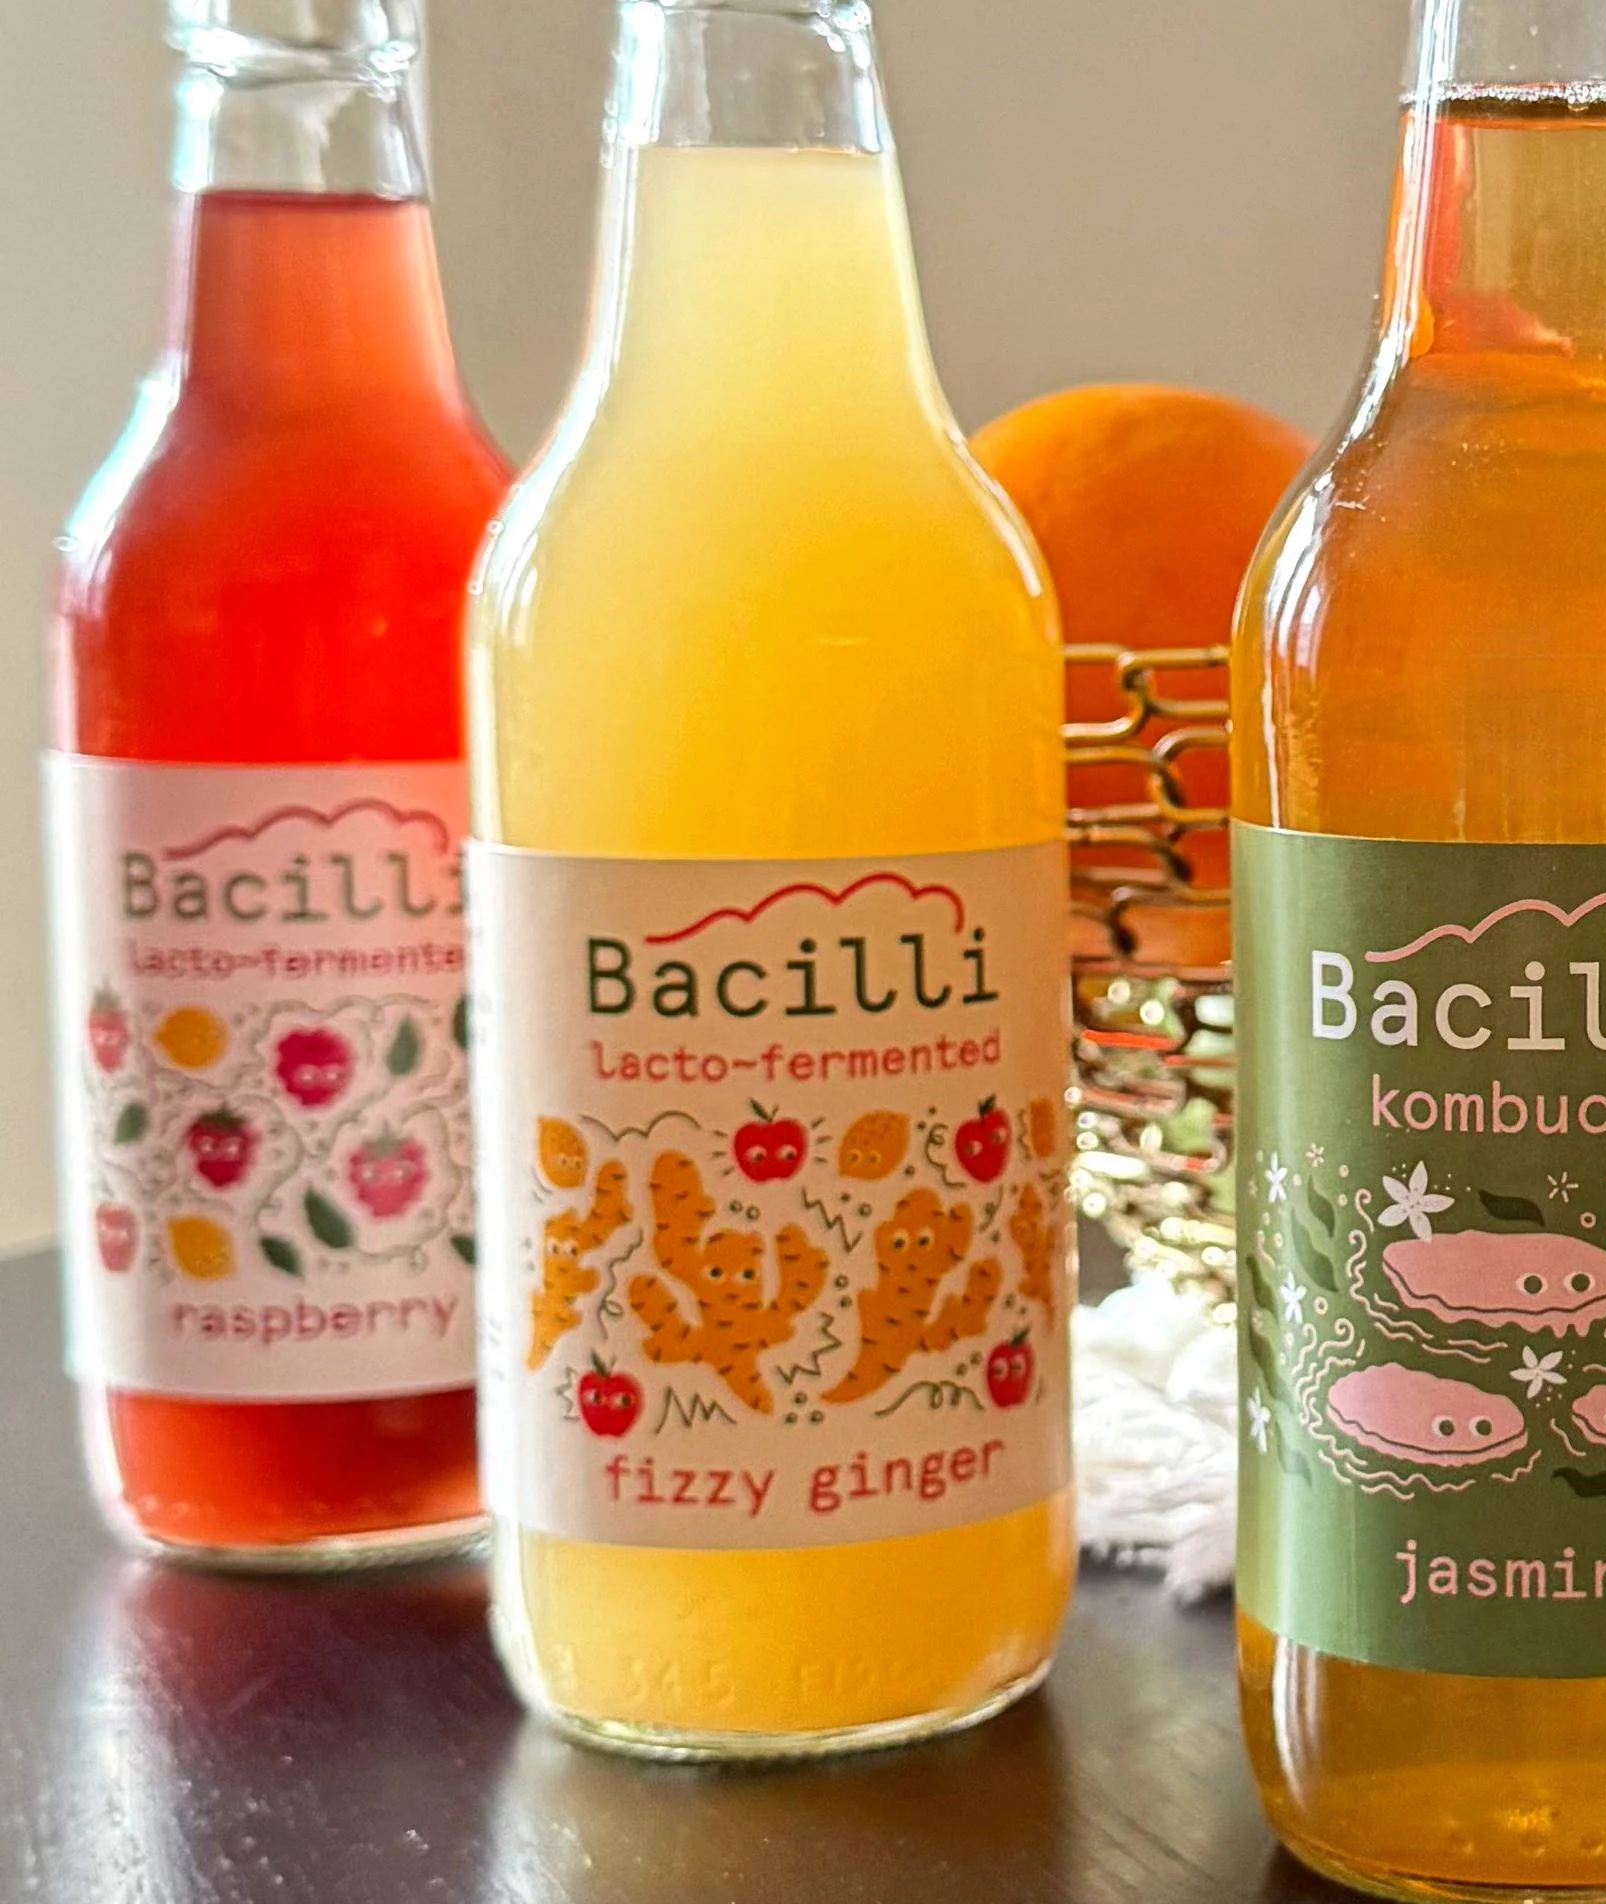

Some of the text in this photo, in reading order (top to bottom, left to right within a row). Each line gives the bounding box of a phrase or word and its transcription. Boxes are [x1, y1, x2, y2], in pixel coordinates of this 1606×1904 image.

[587, 927, 999, 1018] Bacilli
[171, 1296, 459, 1347] raspberry
[604, 1438, 1006, 1518] fizzy ginger
